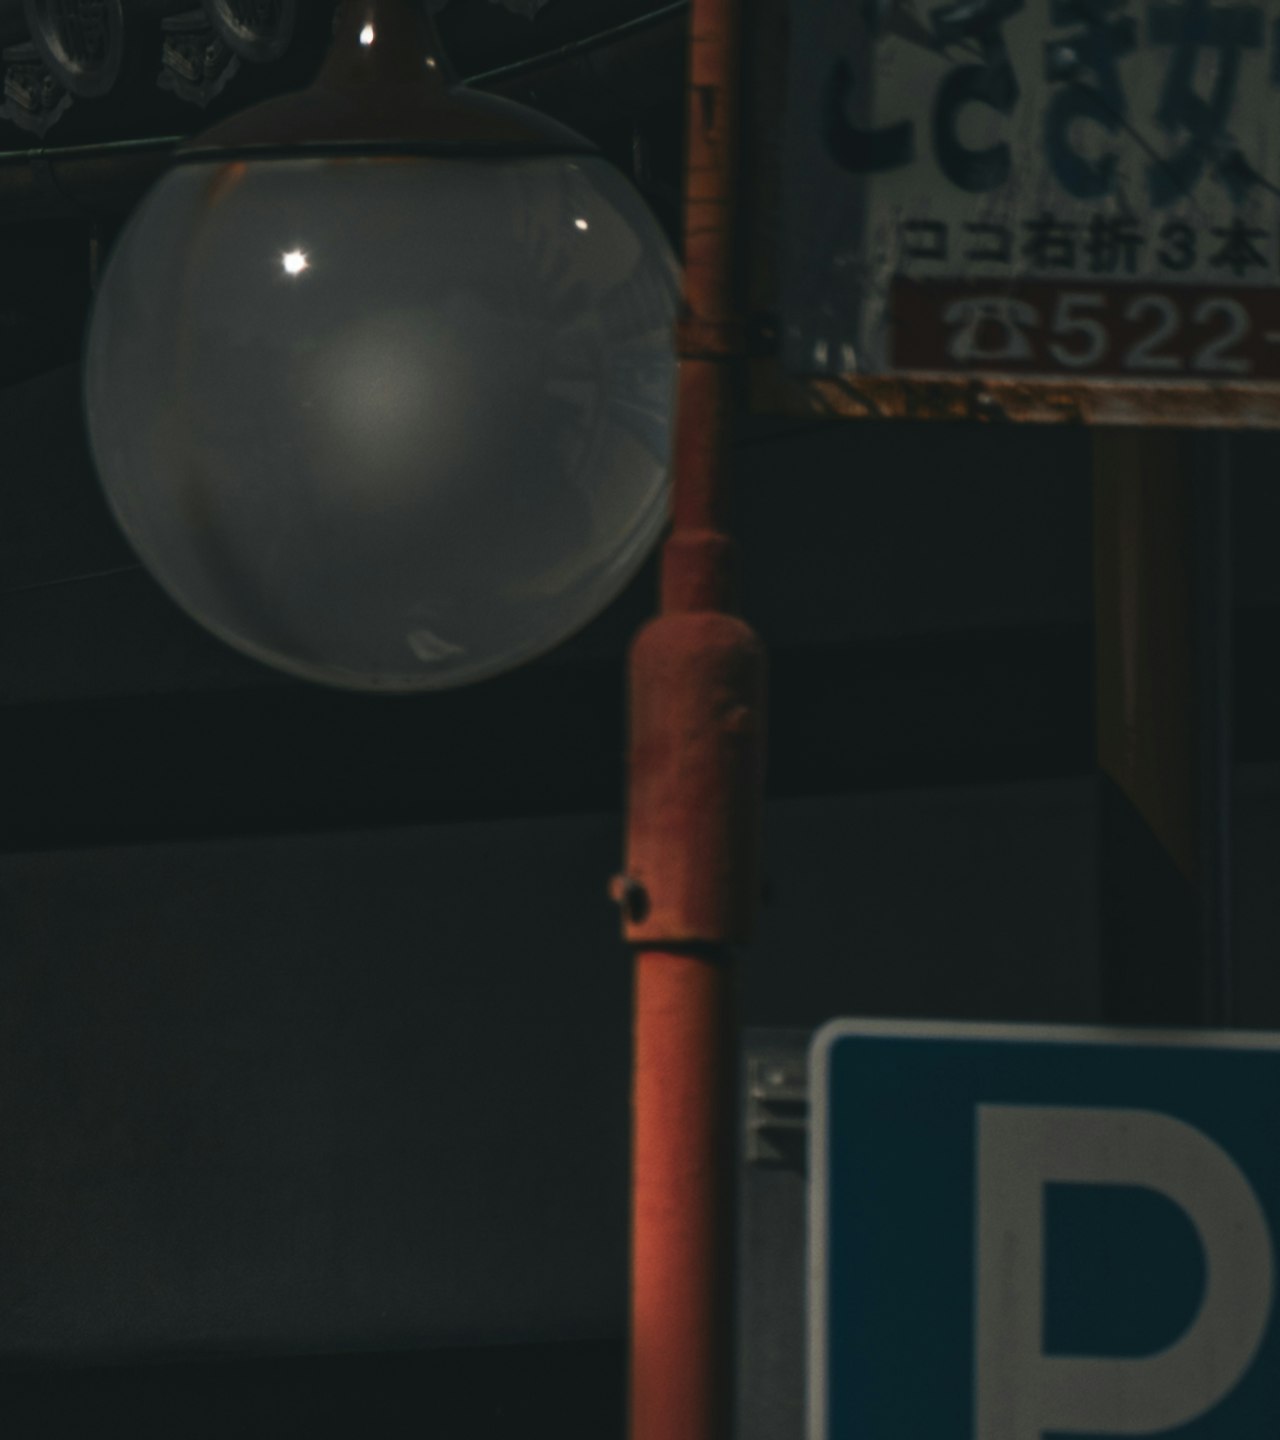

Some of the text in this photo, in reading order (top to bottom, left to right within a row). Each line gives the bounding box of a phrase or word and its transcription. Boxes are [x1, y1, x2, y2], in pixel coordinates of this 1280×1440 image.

[902, 212, 1270, 277] ココ右折3本
